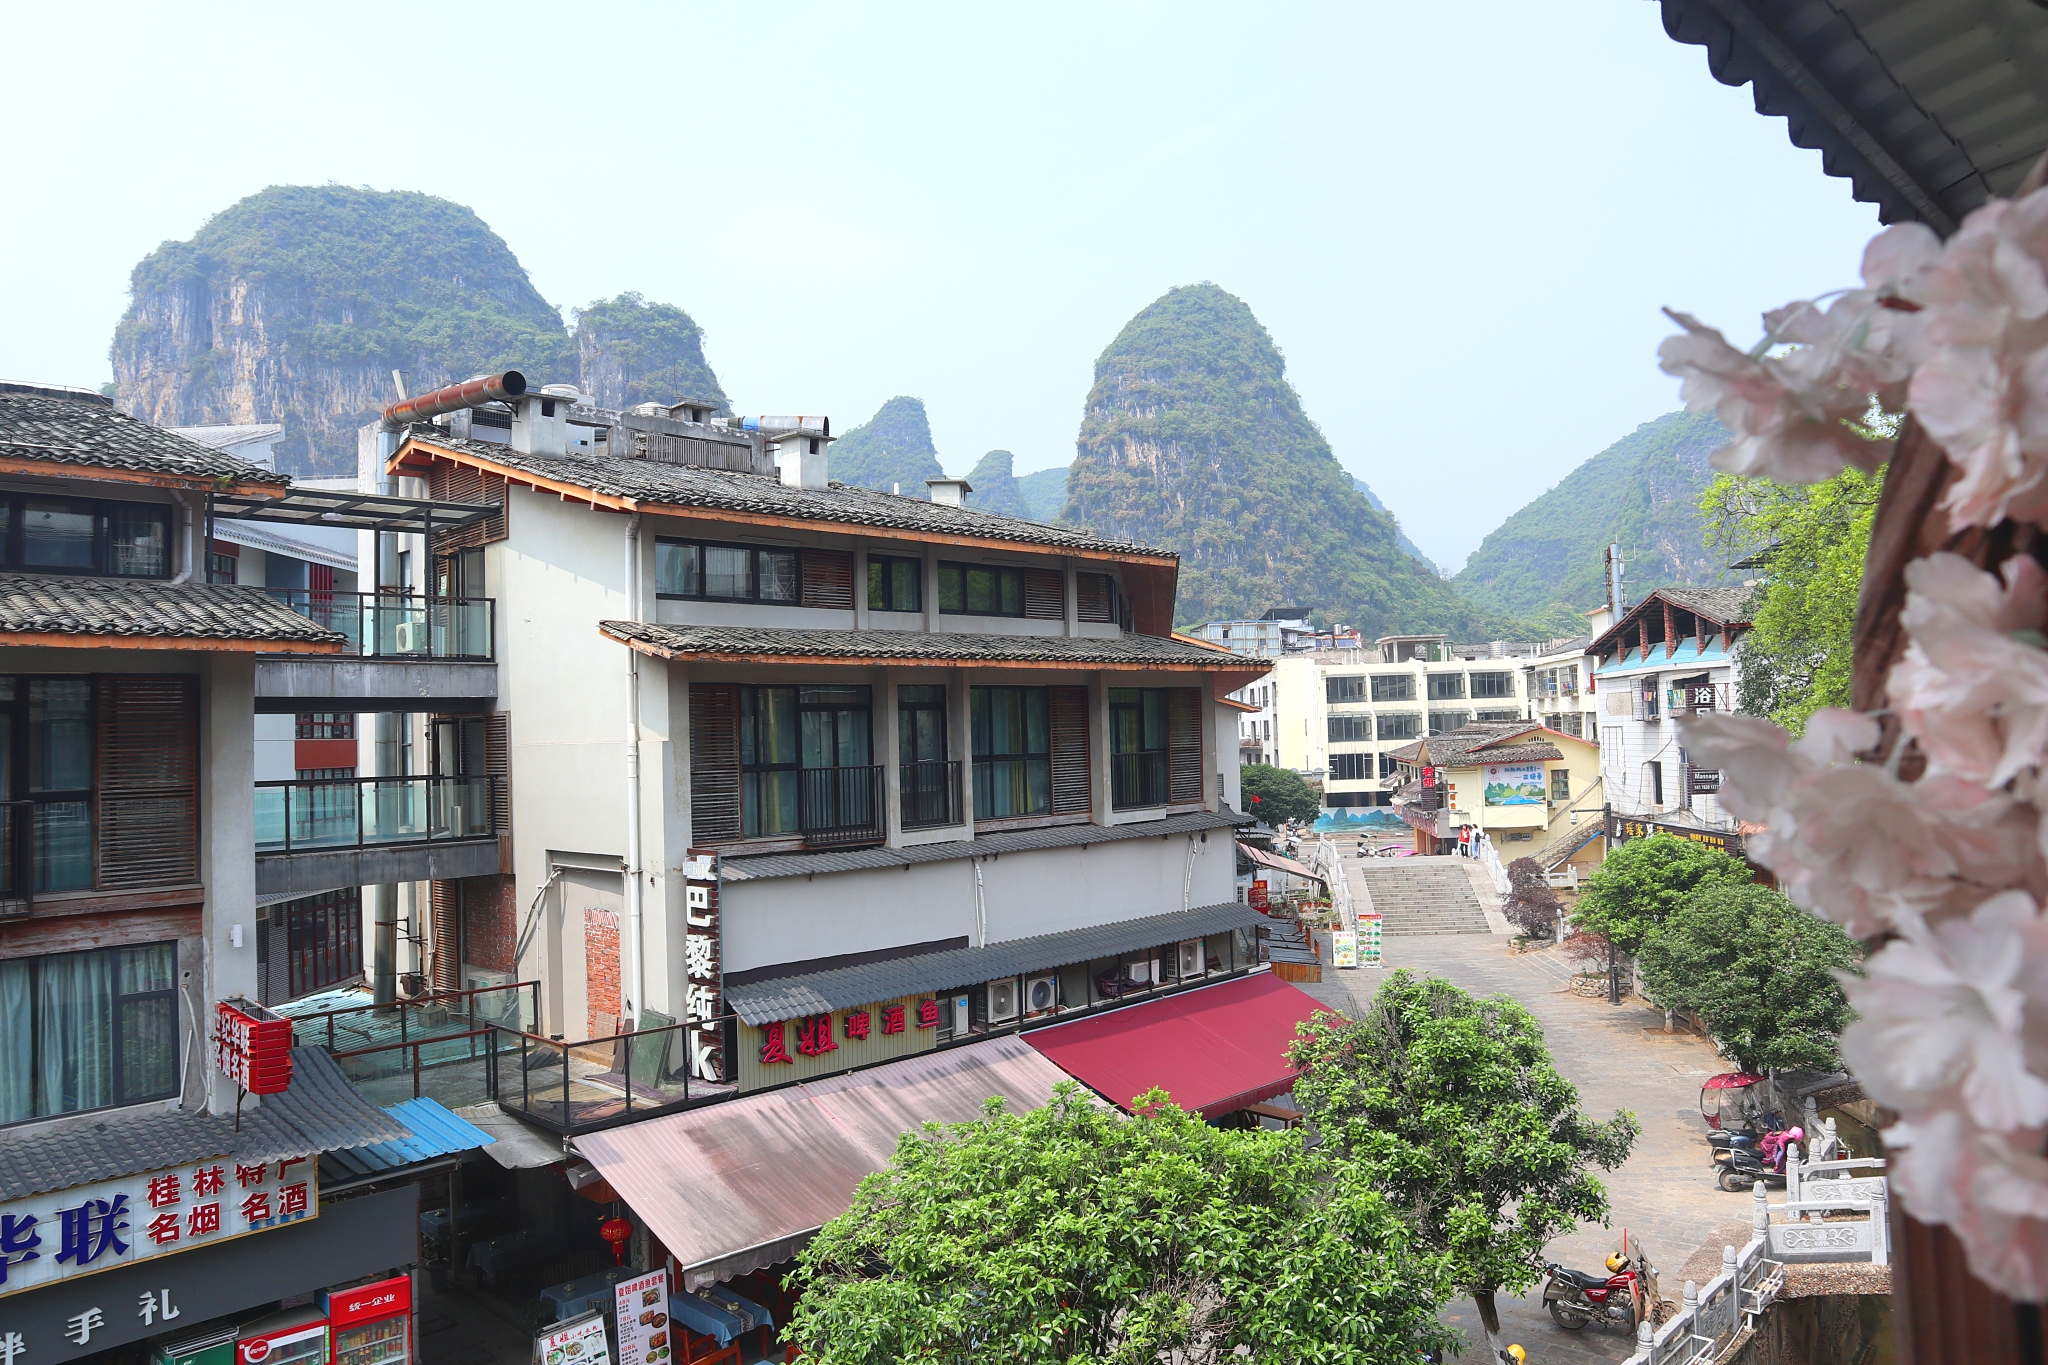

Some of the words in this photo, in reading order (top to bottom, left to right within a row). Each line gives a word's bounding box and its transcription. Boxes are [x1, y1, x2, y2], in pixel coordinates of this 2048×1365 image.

[760, 1000, 940, 1065] 夏姐啤酒鱼
[214, 1039, 250, 1092] 名烟名酒
[147, 1181, 308, 1245] 名烟名酒
[348, 1293, 396, 1313] 统一企业
[618, 1273, 665, 1298] 夏姐啤酒鱼套餐
[620, 1342, 637, 1353] 108元
